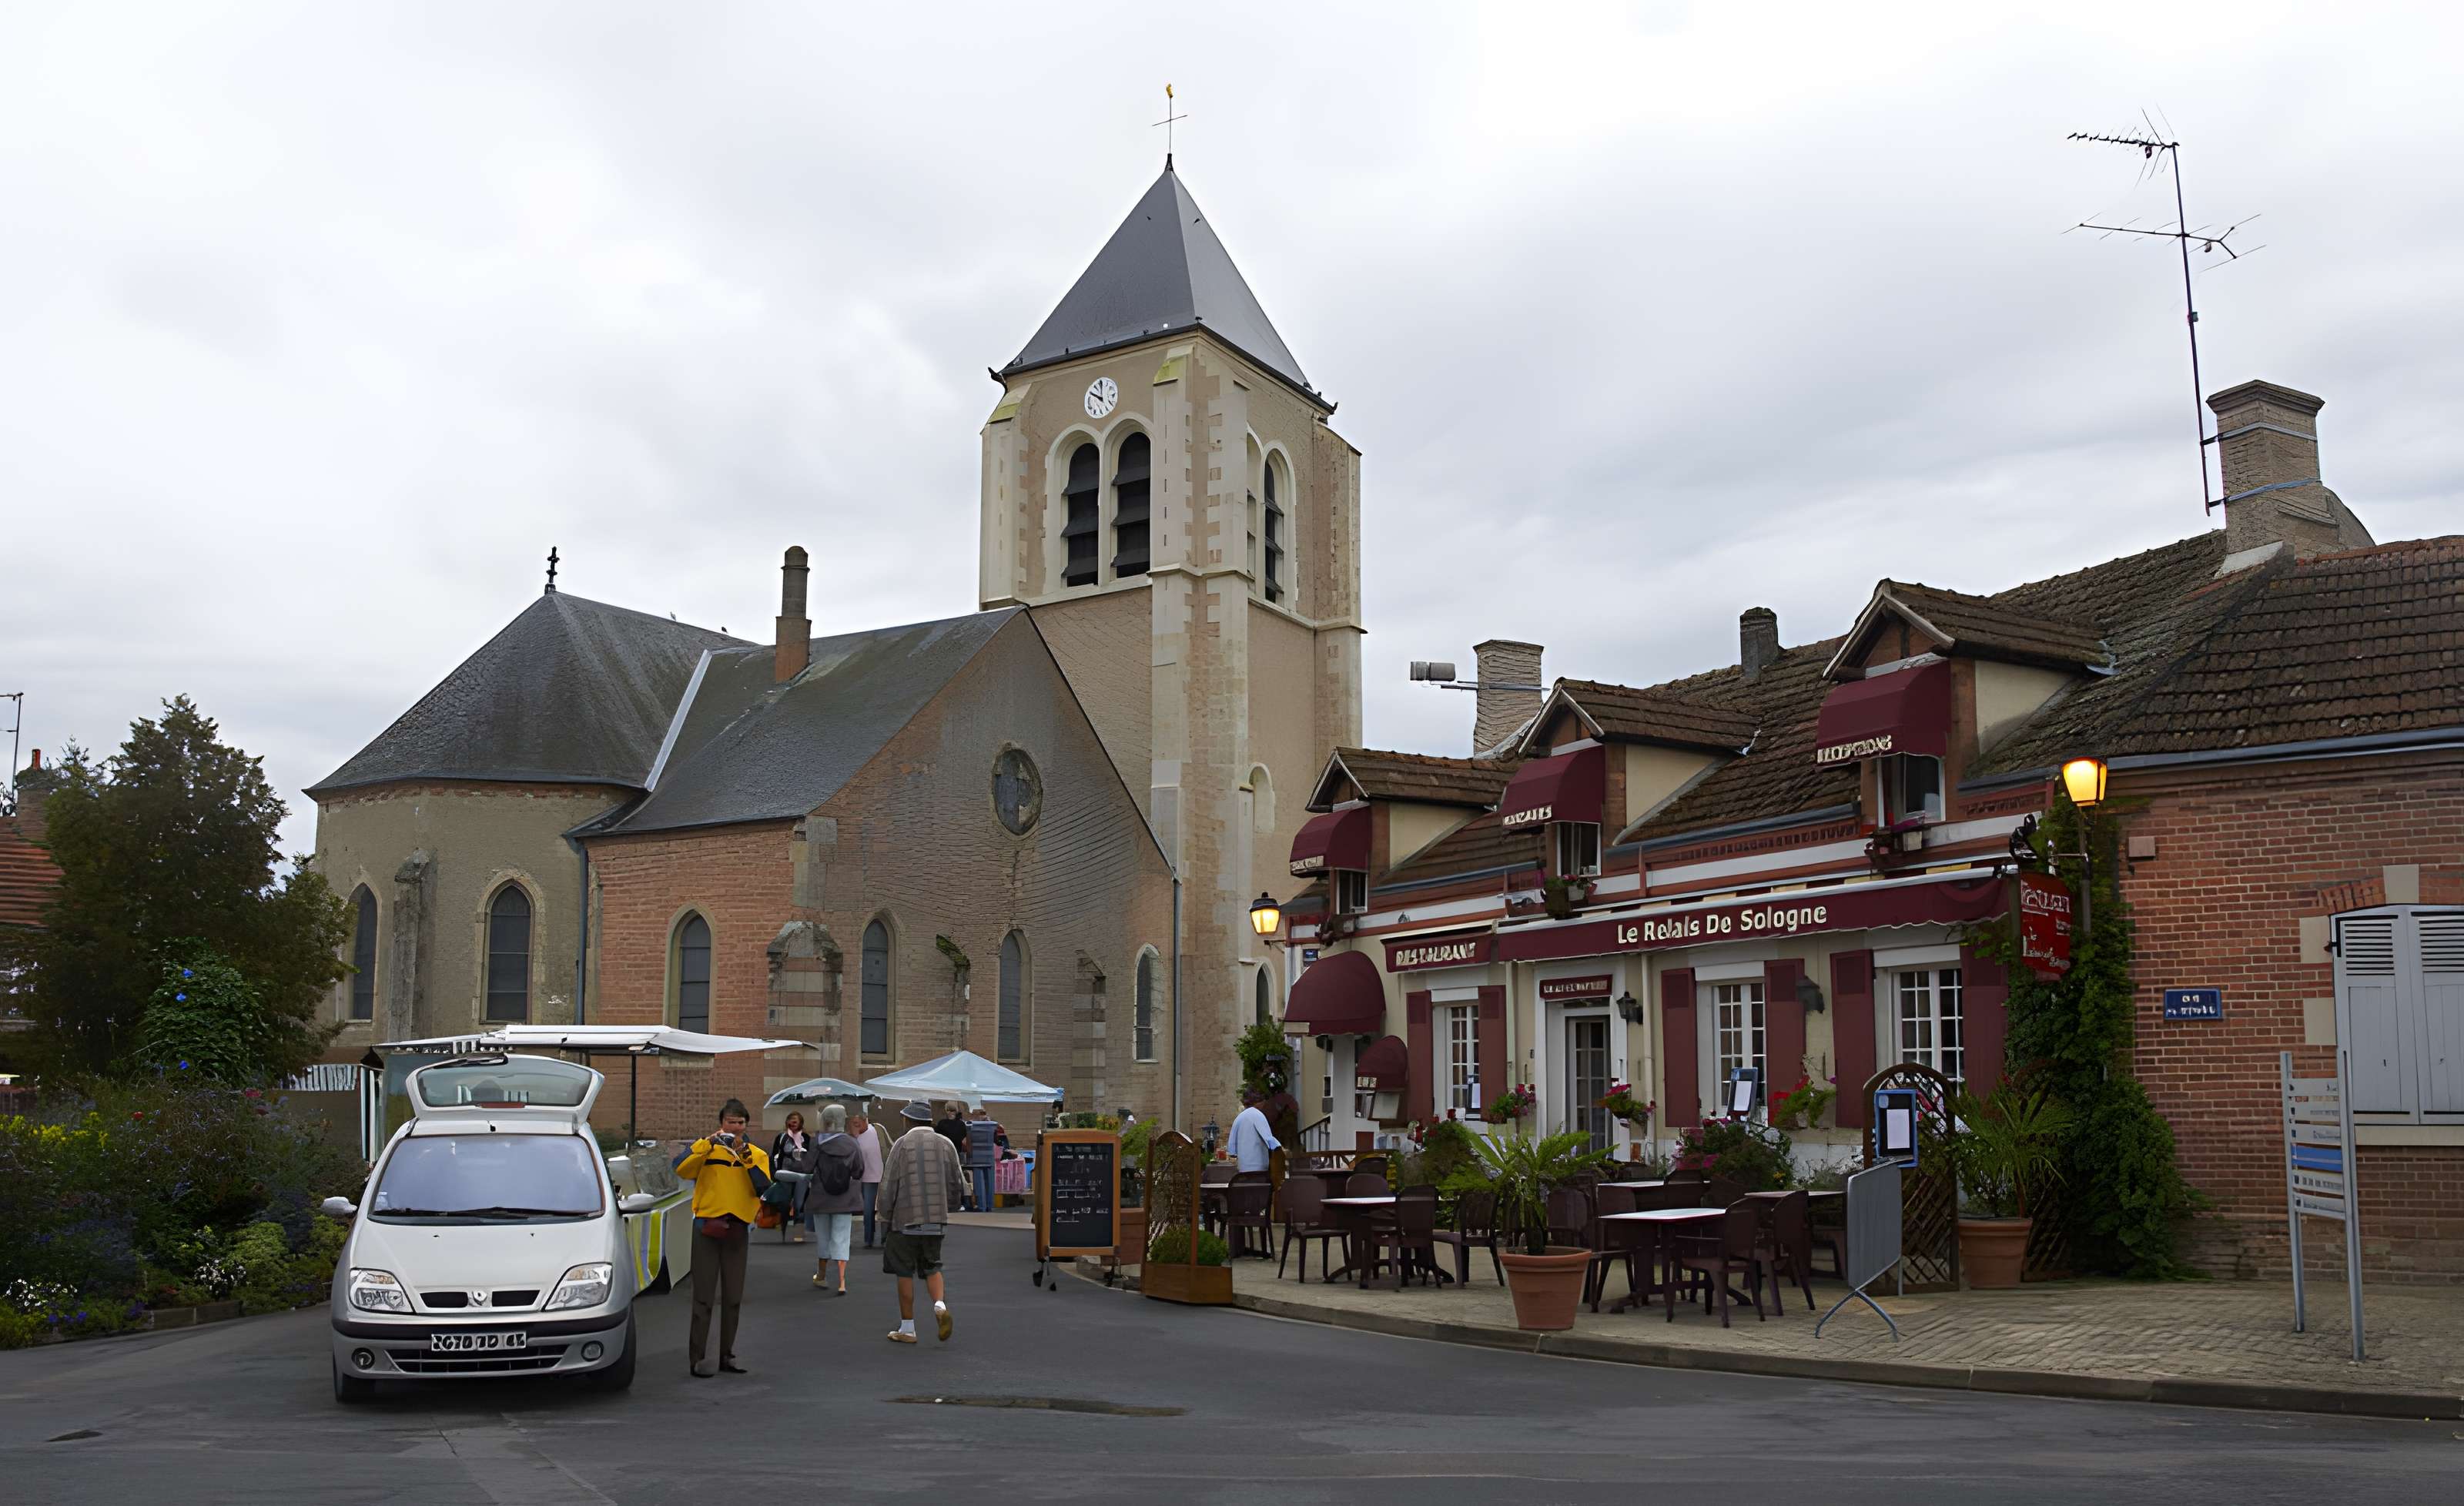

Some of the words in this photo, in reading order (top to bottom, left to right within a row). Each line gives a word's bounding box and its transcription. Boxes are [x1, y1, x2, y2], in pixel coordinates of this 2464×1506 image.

[1617, 924, 1639, 944] Le
[1644, 915, 1700, 942] Relais
[1740, 905, 1827, 932] Sologne
